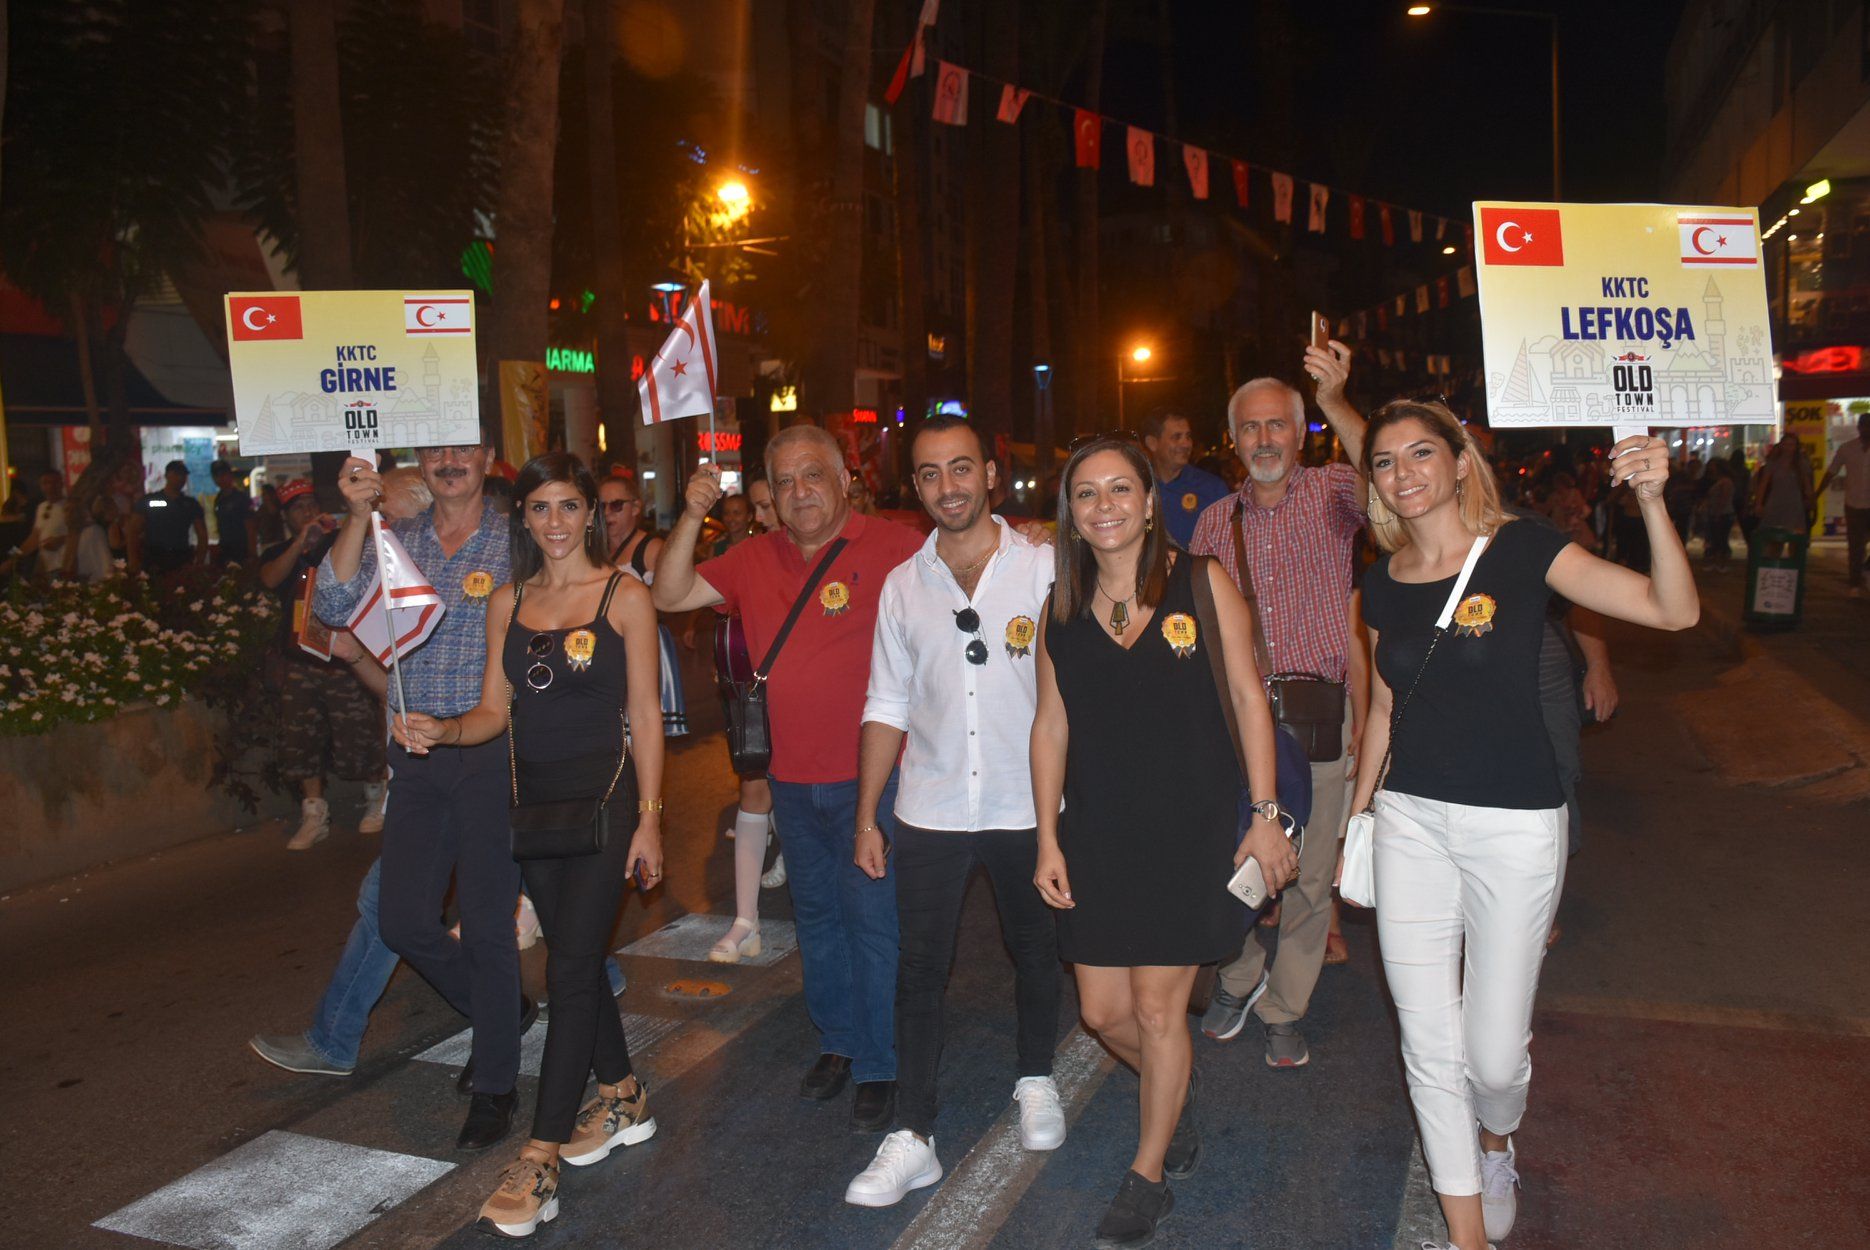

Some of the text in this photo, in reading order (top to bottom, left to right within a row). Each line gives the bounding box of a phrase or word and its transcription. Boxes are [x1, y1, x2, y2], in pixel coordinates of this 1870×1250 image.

[1601, 276, 1649, 298] KKTC
[1561, 306, 1695, 349] LEFKOŞA
[336, 345, 377, 361] KKTC
[320, 362, 397, 393] GİRNE
[1613, 365, 1652, 392] OLD
[1615, 393, 1653, 406] TOWN
[345, 409, 378, 429] OLD
[347, 429, 378, 439] TOWN
[1468, 604, 1483, 613] OLD
[1173, 622, 1186, 630] OLD
